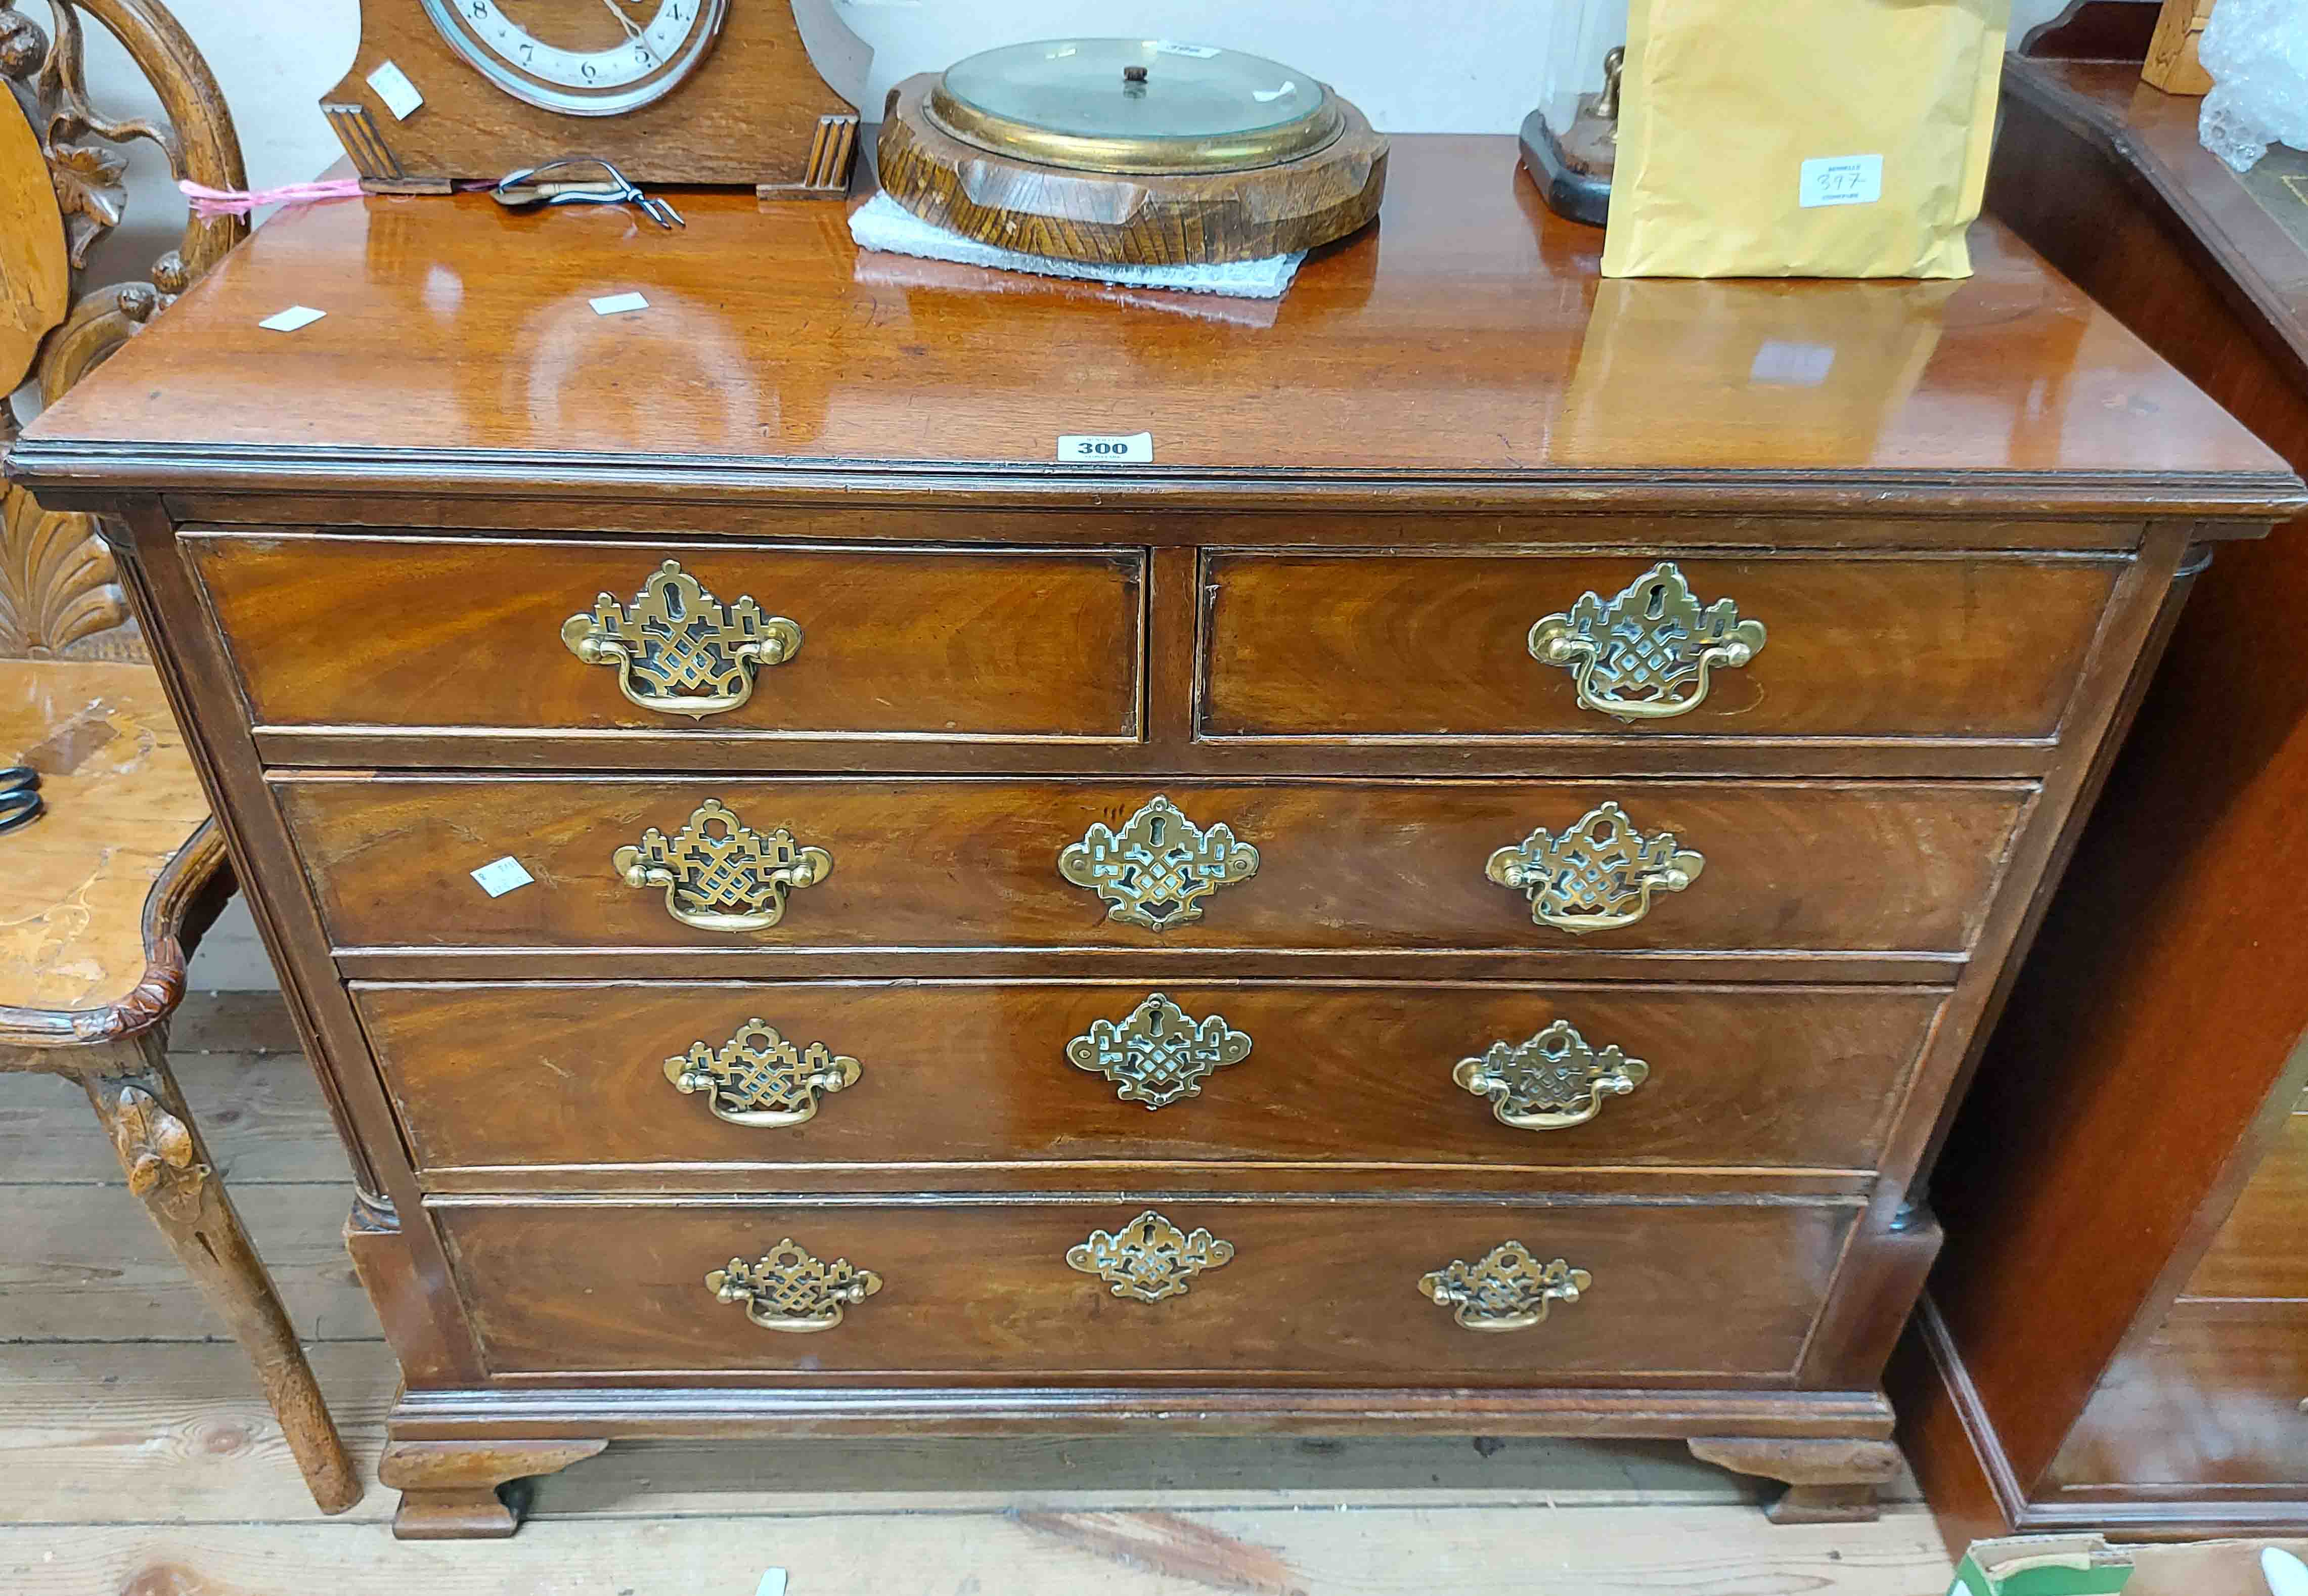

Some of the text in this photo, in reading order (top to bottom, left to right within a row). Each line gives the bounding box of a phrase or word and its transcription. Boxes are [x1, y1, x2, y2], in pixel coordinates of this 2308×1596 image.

[473, 1, 487, 20] 8
[665, 3, 683, 21] 4
[519, 44, 534, 62] 7
[635, 45, 650, 64] 5
[581, 61, 596, 79] 6
[1077, 442, 1128, 454] 300
